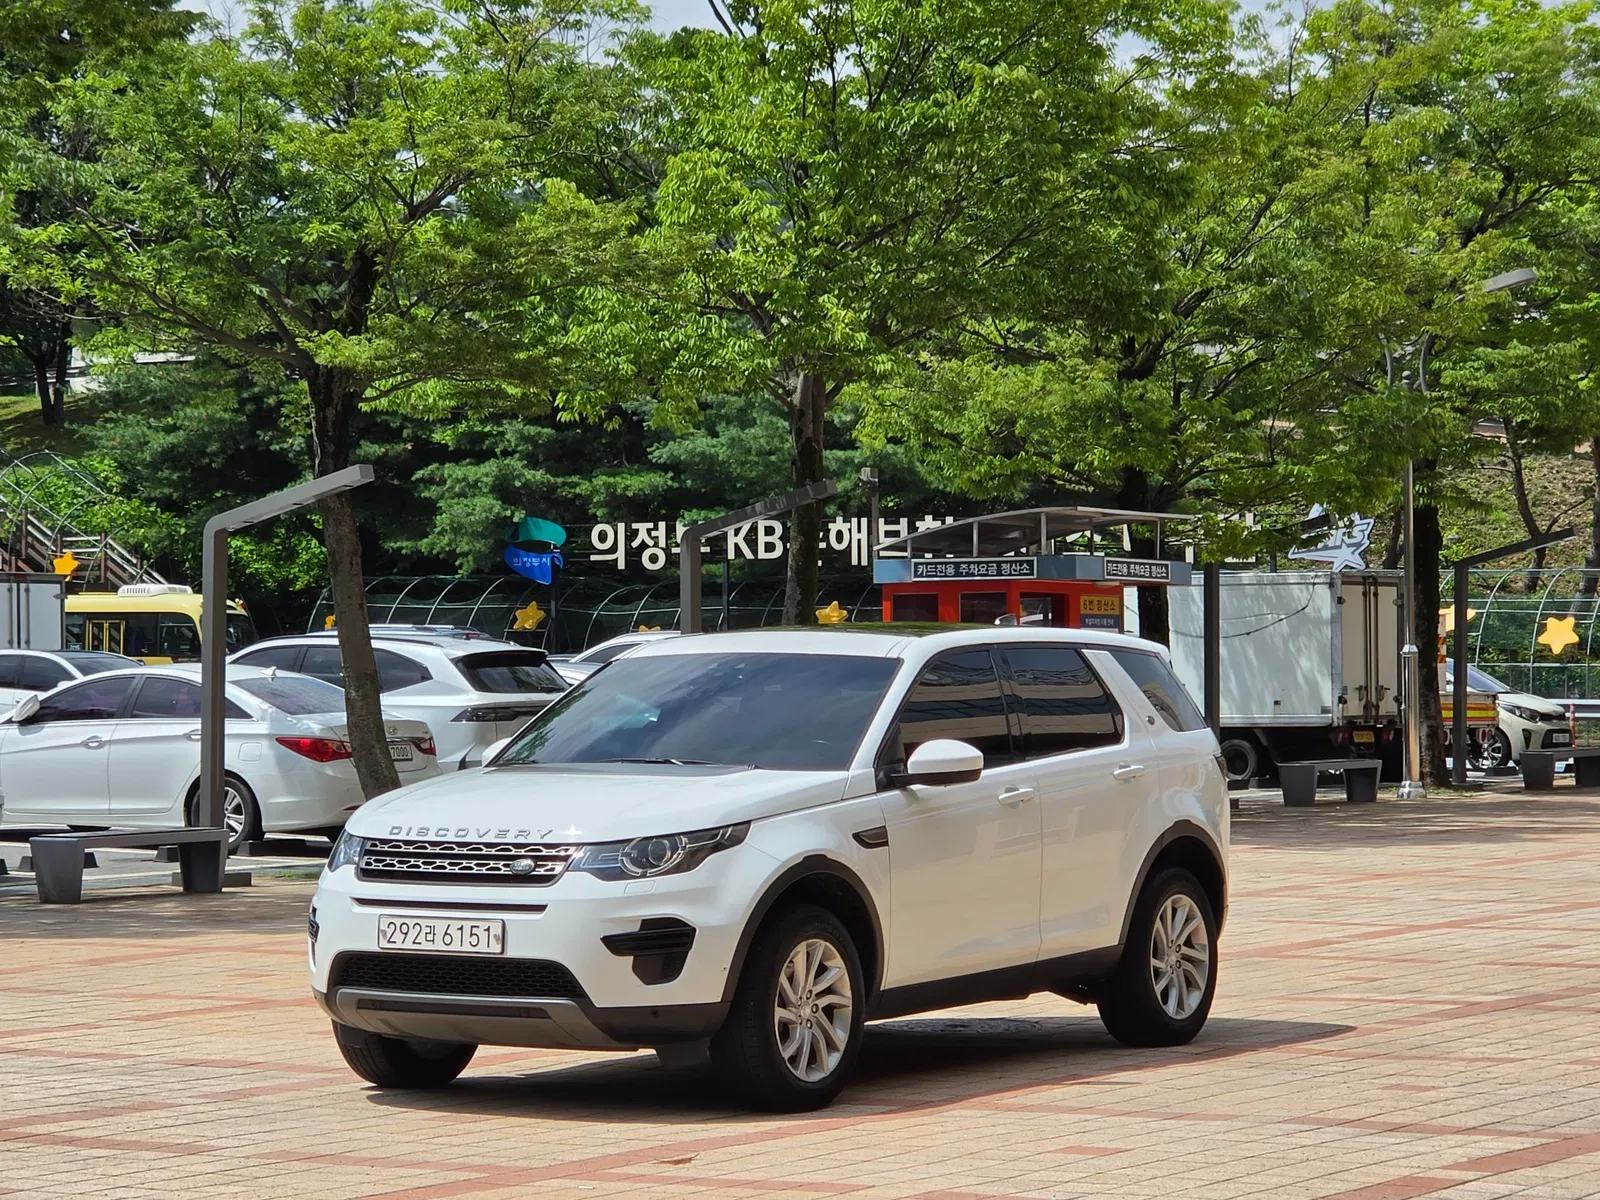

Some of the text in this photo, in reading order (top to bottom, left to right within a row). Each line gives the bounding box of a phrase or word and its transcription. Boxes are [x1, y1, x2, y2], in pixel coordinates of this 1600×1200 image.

[917, 563, 1031, 577] 카드전용 주차요금 정산소
[1106, 563, 1168, 578] 카드전용 주차요금 정산소
[1096, 599, 1116, 612] 정산소
[390, 746, 409, 758] 7000
[389, 825, 554, 840] DISCOVERY
